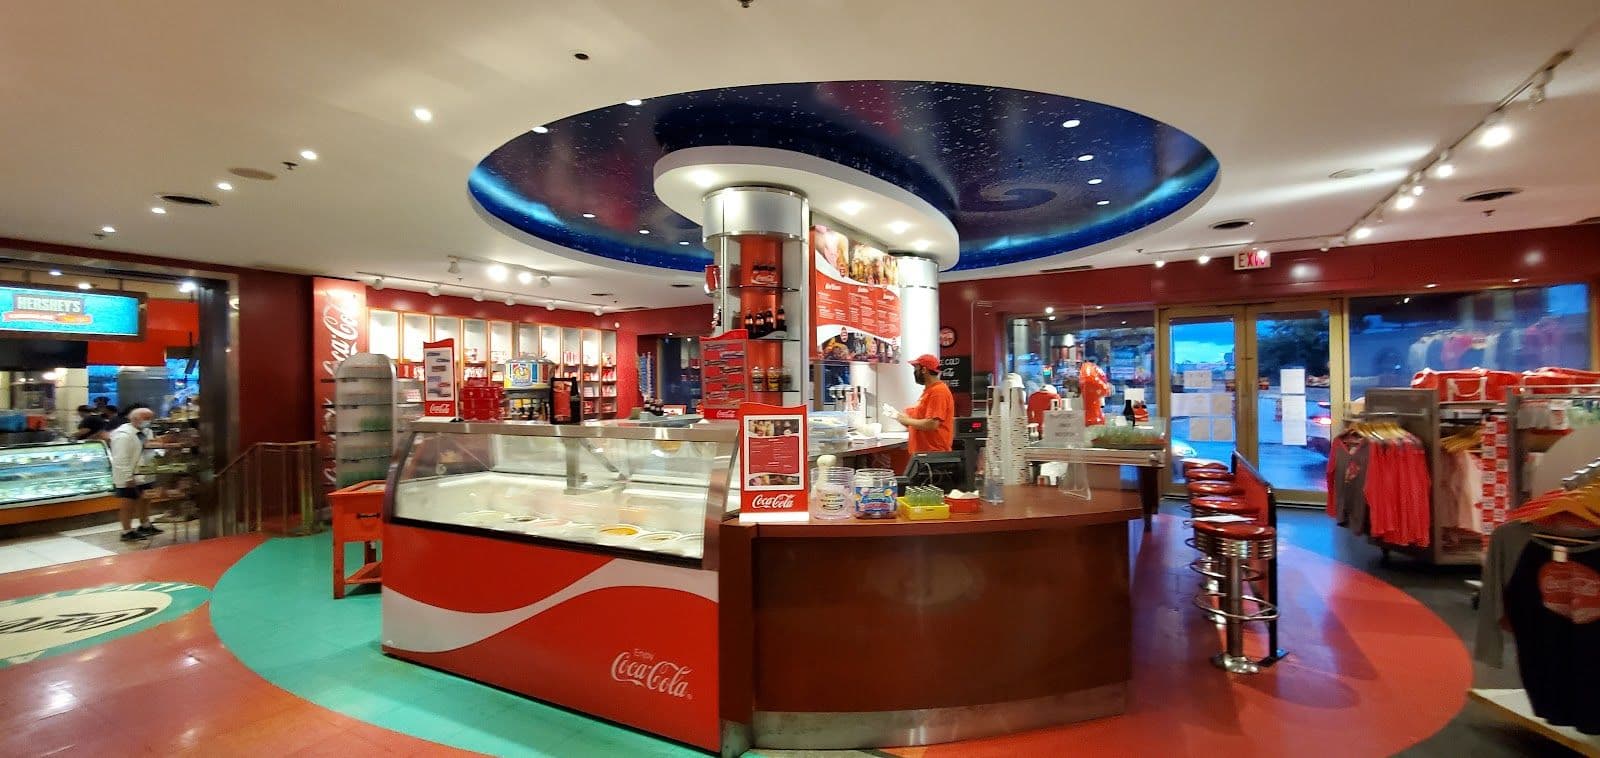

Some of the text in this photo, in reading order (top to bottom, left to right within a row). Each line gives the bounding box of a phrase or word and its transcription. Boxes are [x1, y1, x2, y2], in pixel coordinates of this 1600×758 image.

[16, 296, 82, 313] HERSHEY'S
[751, 493, 797, 509] Coca-Cola
[611, 651, 692, 698] Coca-Cola
